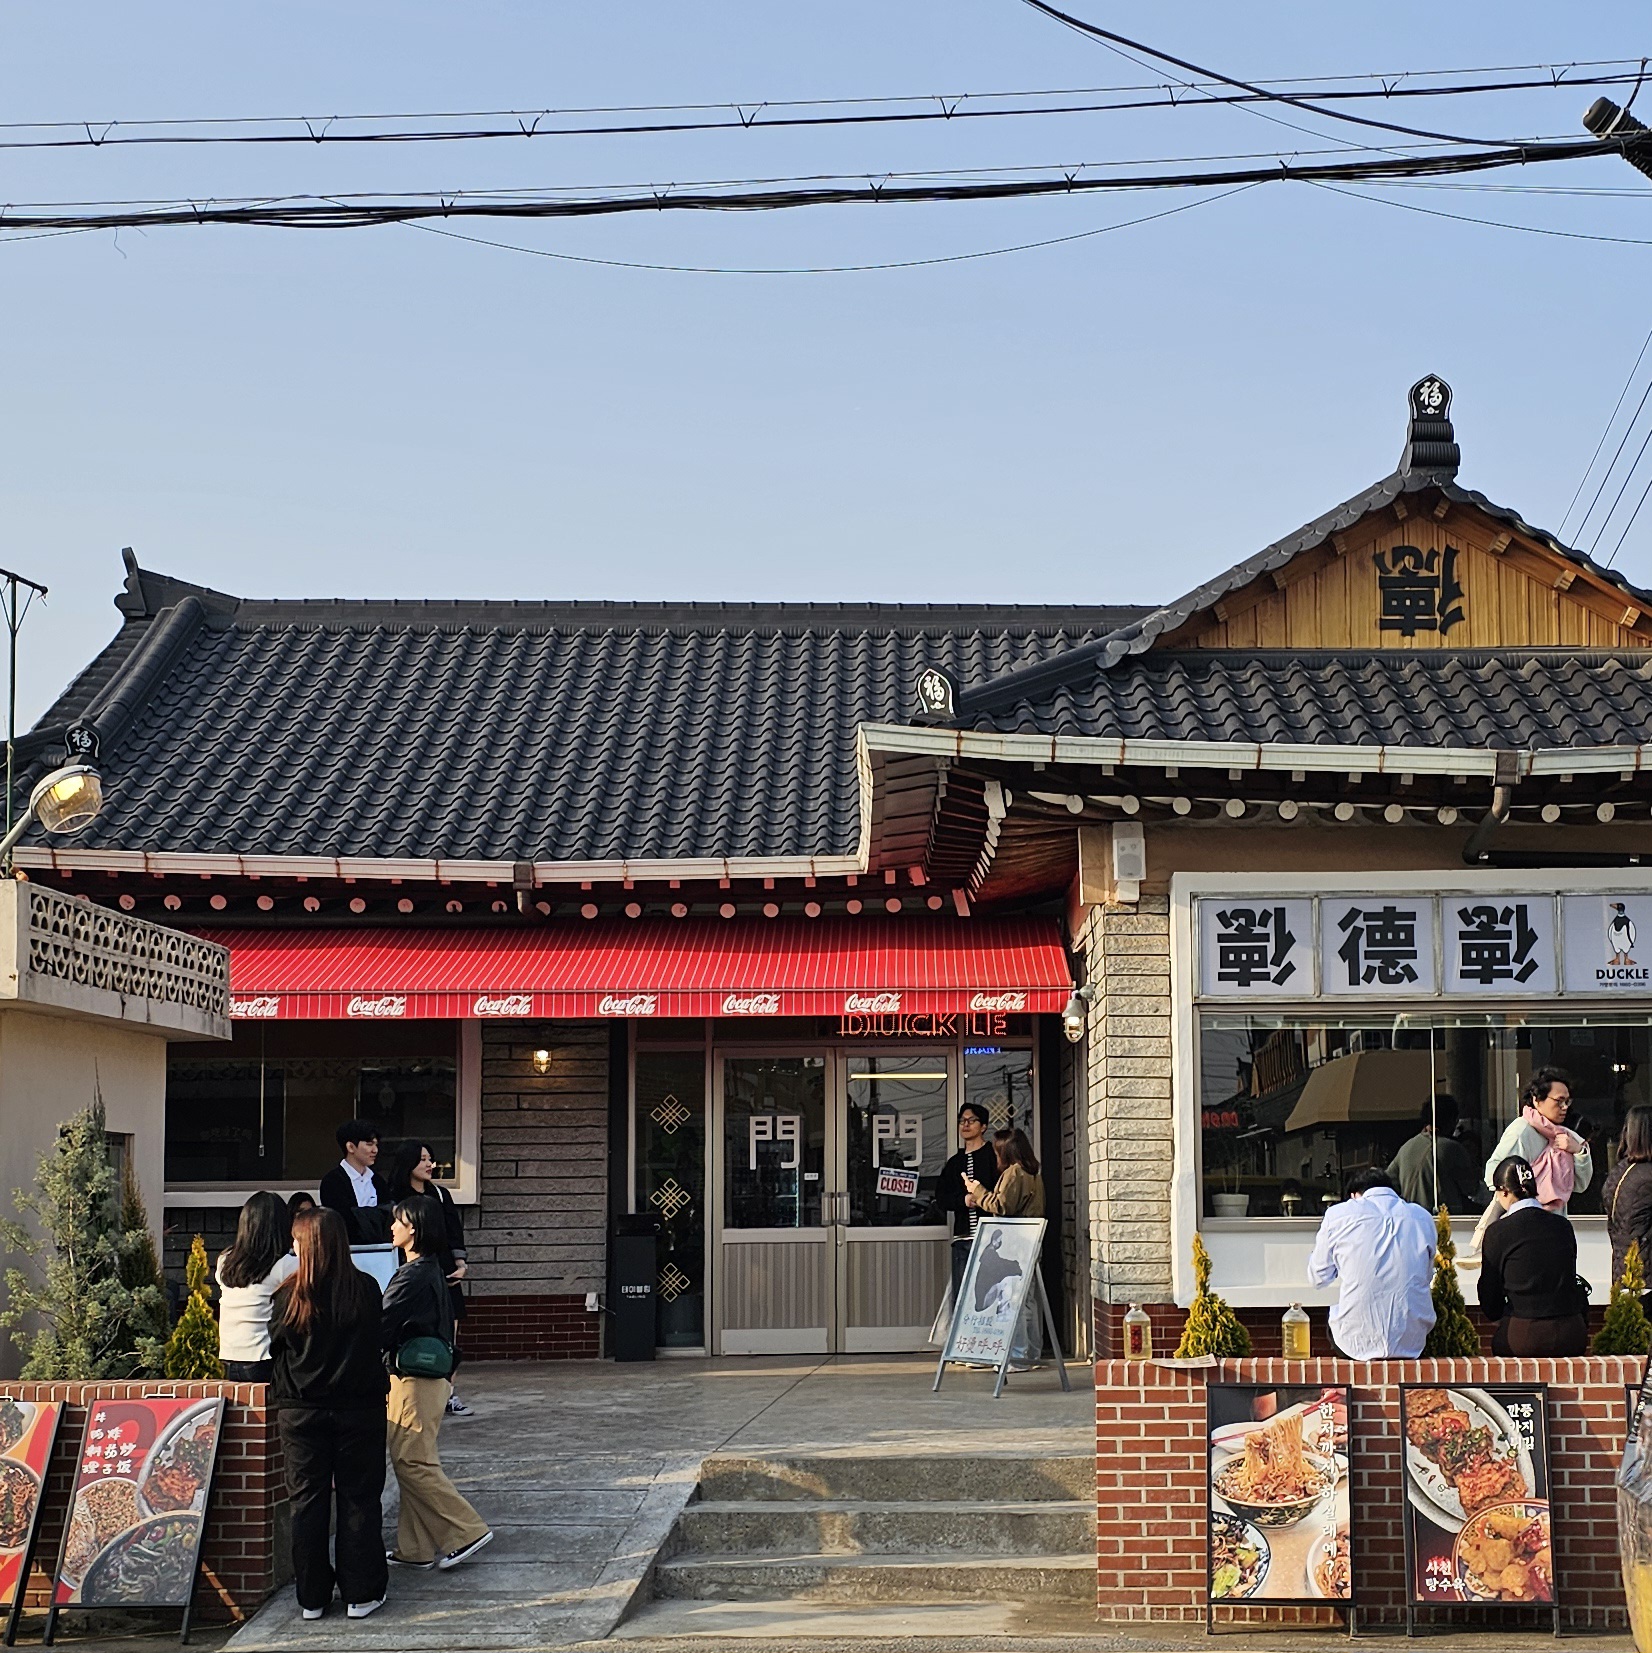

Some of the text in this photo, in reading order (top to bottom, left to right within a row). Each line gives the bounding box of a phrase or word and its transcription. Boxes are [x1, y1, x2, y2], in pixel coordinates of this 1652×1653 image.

[1420, 381, 1443, 408] 福
[923, 675, 945, 702] 福
[71, 729, 93, 748] 福
[1595, 968, 1649, 980] DUCKLE
[750, 1115, 800, 1171] 門
[872, 1114, 923, 1169] 門
[880, 1176, 915, 1194] CLOSED
[1506, 1402, 1534, 1418] 깐풍
[1425, 1560, 1453, 1576] 사천
[1425, 1577, 1466, 1593] 탕수육
